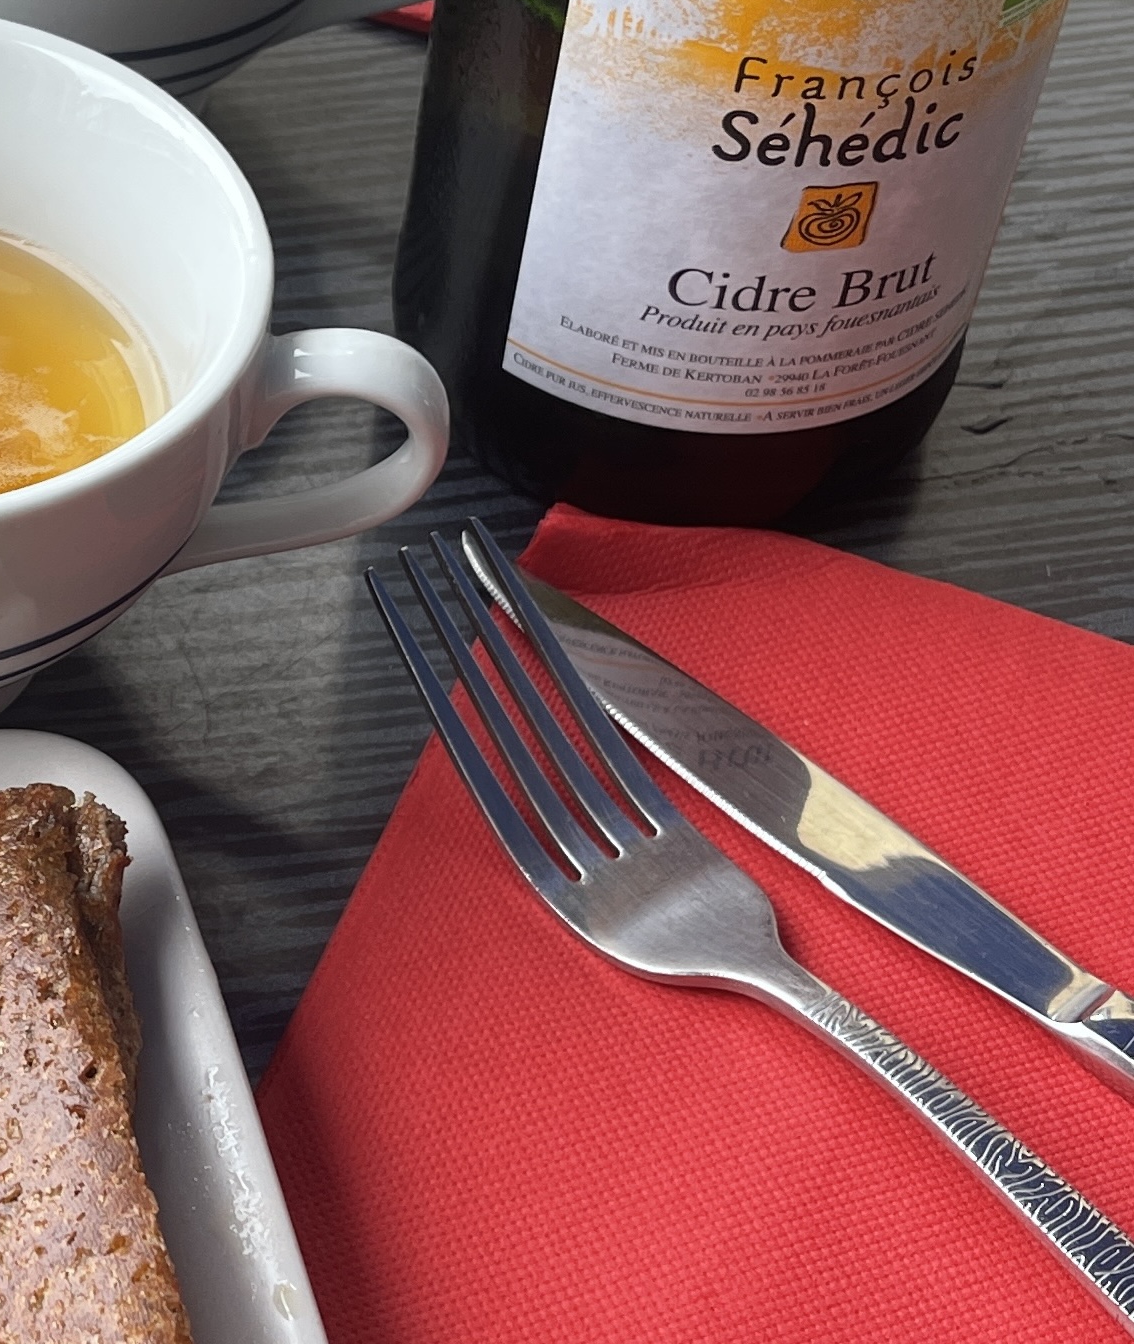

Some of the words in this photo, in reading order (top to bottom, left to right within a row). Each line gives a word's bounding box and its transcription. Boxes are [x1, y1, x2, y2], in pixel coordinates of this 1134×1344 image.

[733, 49, 978, 110] François
[711, 95, 964, 168] Séhédic
[667, 267, 817, 313] Cidre
[831, 251, 937, 310] Brut
[639, 305, 727, 335] Produit
[731, 322, 759, 337] en
[762, 321, 819, 341] pays
[816, 283, 941, 339] fouesnantais
[611, 352, 660, 374] FERME
[662, 366, 682, 379] DE
[683, 368, 764, 385] KERTOBAN
[621, 339, 639, 352] ET
[640, 344, 665, 358] MIS
[667, 349, 687, 362] EN
[688, 352, 765, 368] BOUTEILLE
